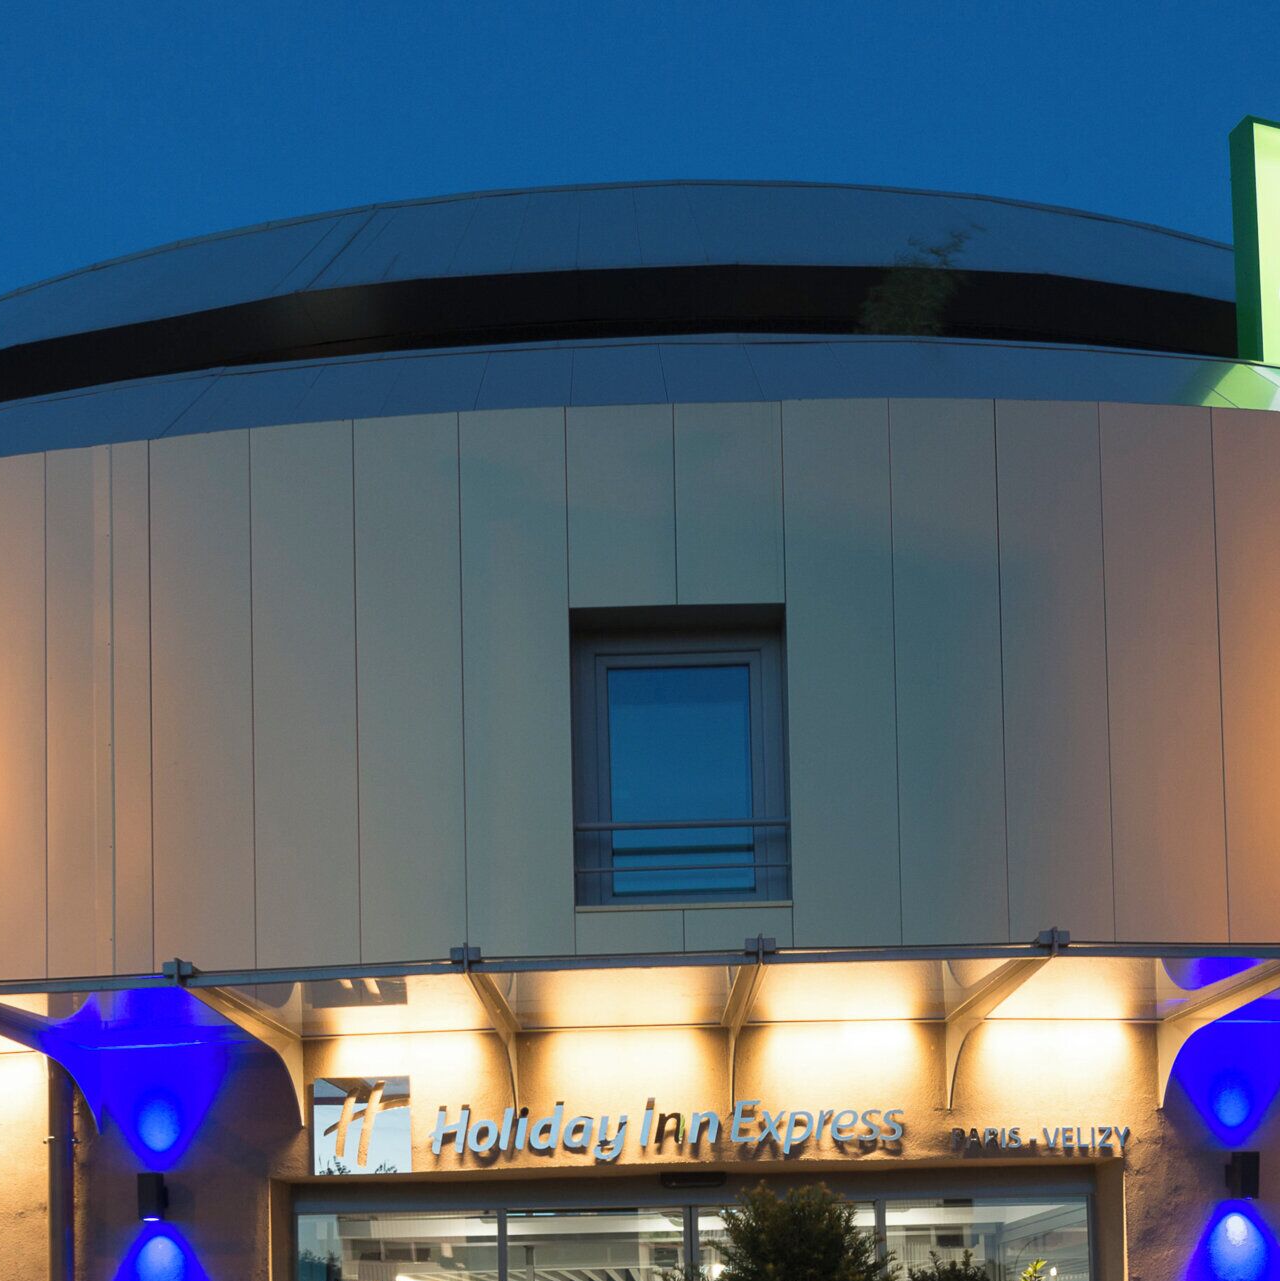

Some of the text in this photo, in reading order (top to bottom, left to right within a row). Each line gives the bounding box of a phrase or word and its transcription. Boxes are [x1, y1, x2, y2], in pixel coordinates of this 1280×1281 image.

[428, 1096, 905, 1161] Holiday Inn Express
[951, 1127, 1023, 1149] PARIS
[1042, 1126, 1131, 1149] VELIZY
